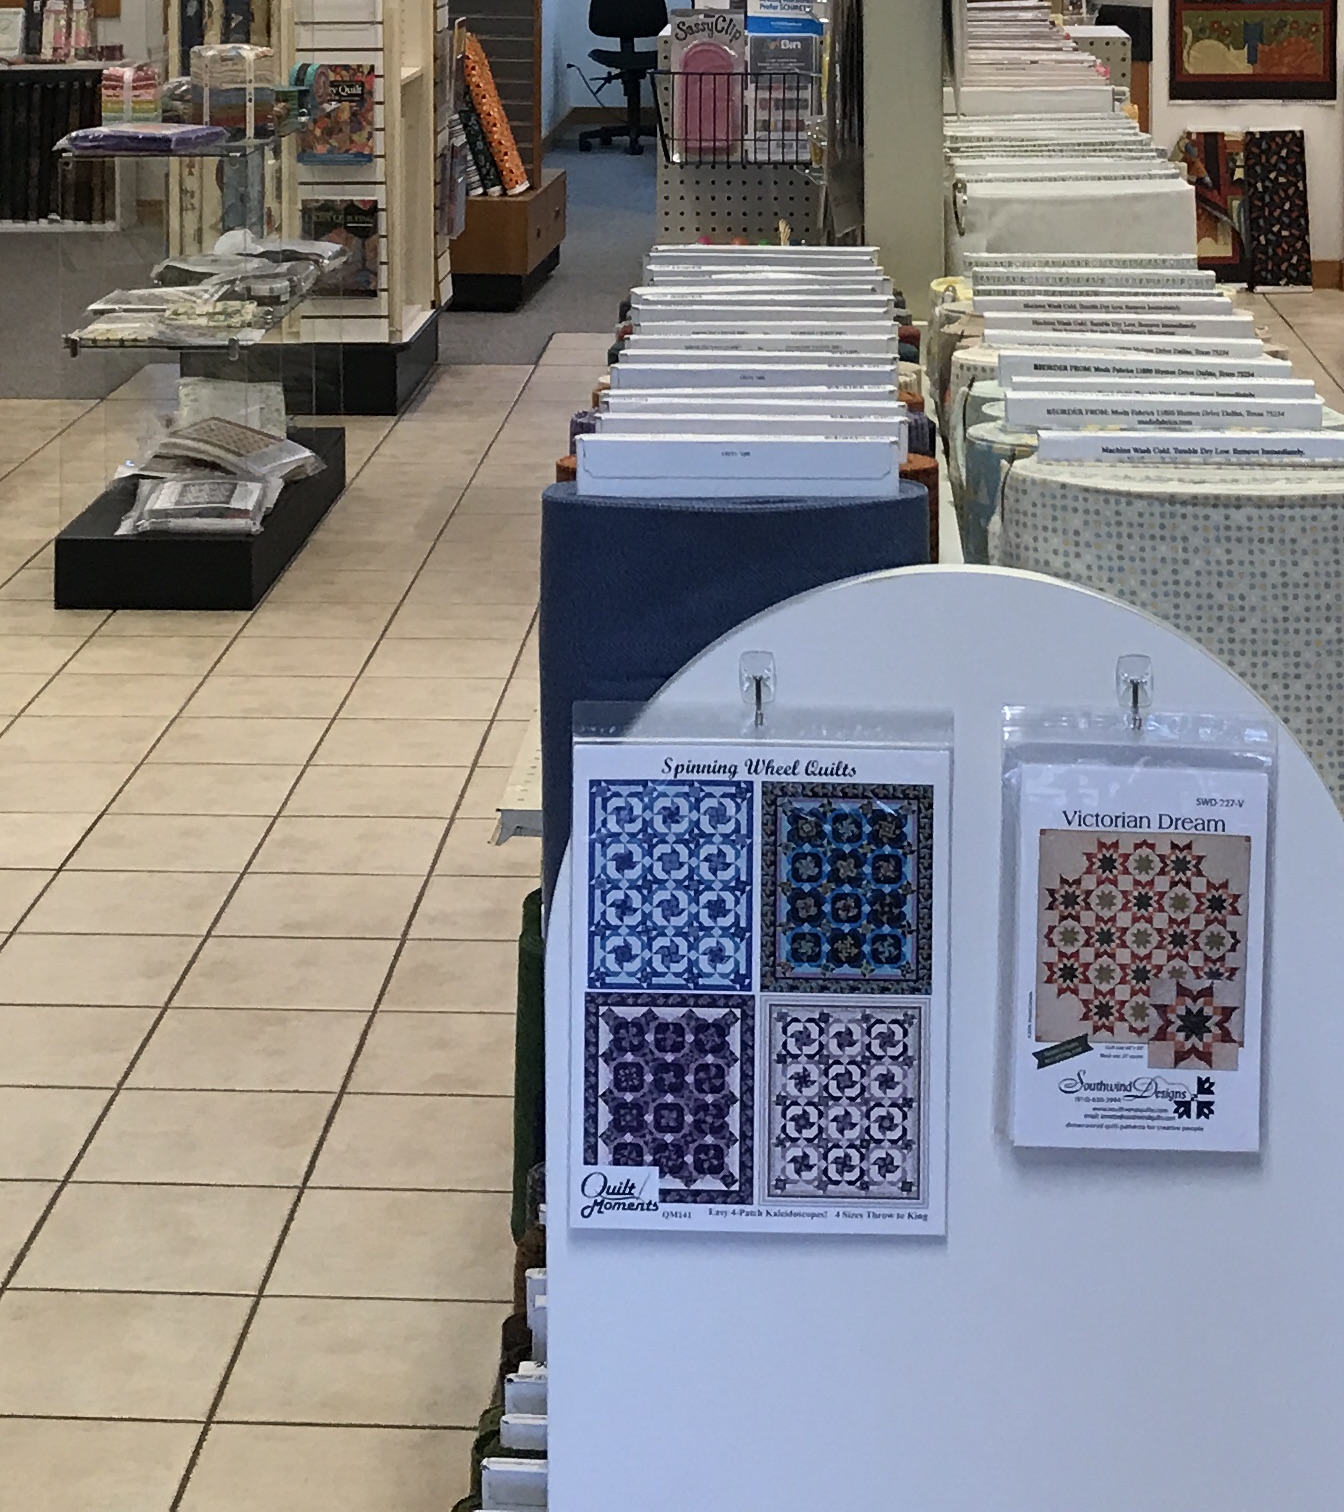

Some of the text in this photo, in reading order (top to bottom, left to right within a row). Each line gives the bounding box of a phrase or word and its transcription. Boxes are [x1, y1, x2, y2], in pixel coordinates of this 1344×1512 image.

[675, 15, 742, 44] SassyClip
[1132, 447, 1151, 455] Wash
[1200, 448, 1213, 456] Dry
[661, 756, 857, 780] Spinning Wheel Quilts
[1062, 810, 1226, 832] Victorian Dream
[1058, 1069, 1187, 1102] Southwind Designs
[581, 1172, 637, 1199] Quilt
[581, 1198, 659, 1219] Moments
[842, 1211, 864, 1219] Sizes
[866, 1211, 894, 1219] Throw
[896, 1211, 905, 1219] to
[907, 1212, 929, 1222] King
